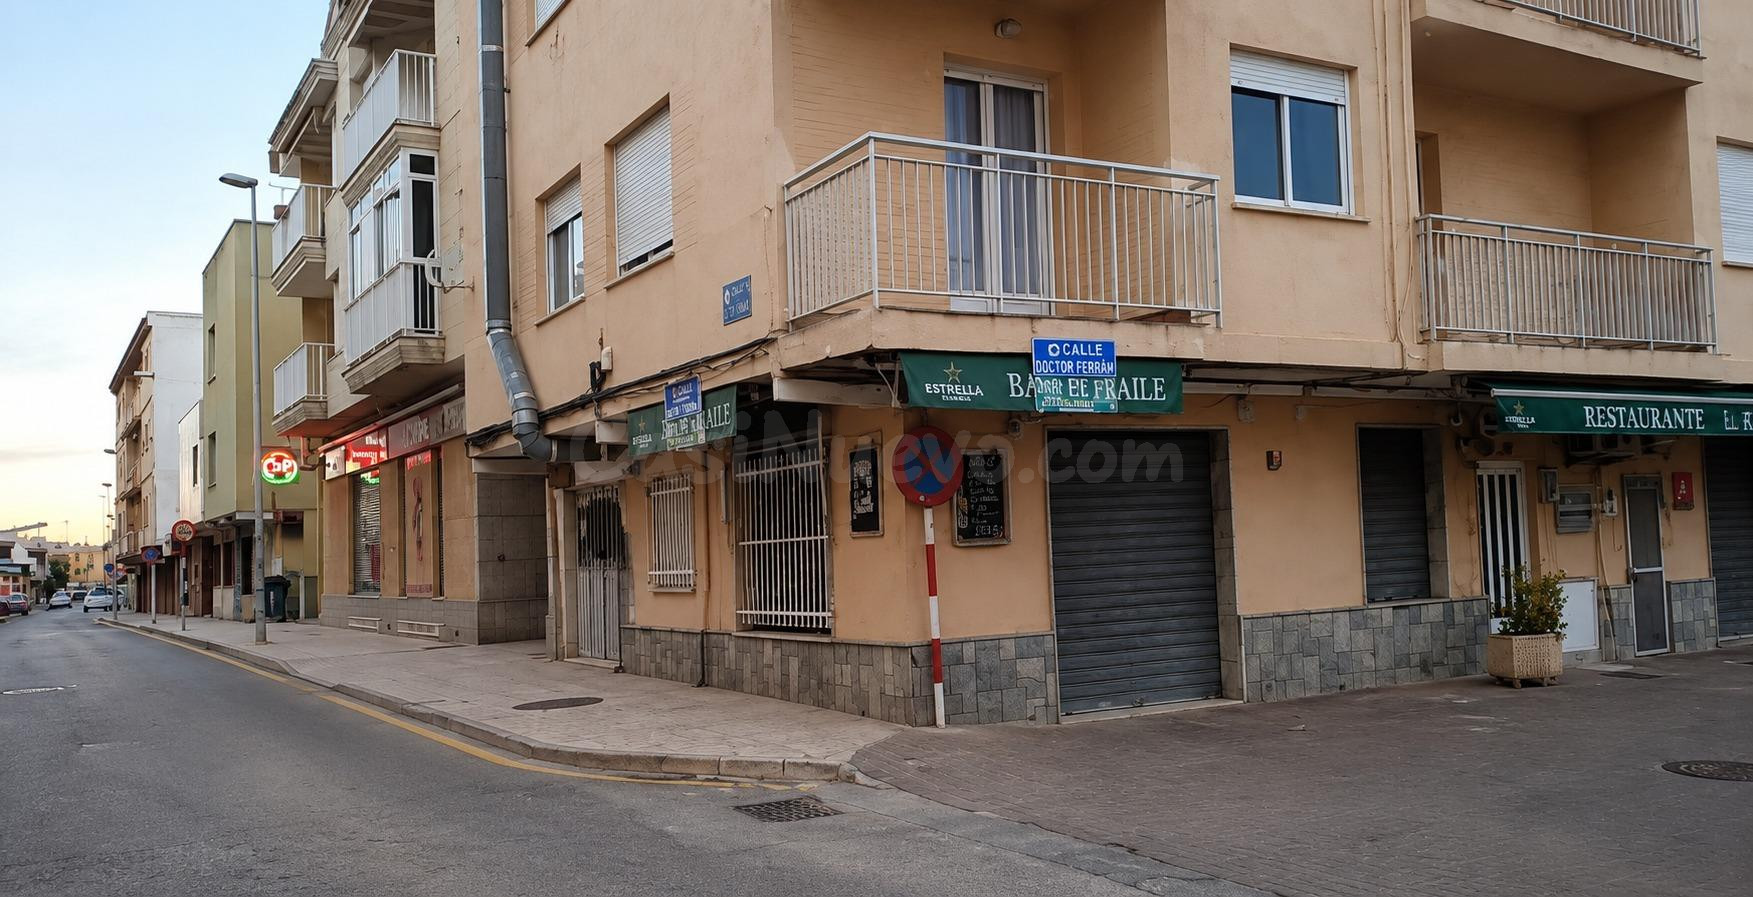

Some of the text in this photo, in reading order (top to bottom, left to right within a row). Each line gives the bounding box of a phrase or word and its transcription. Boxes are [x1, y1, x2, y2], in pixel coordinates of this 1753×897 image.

[1062, 343, 1103, 356] CALLE
[1036, 360, 1074, 373] DOCTOR
[925, 383, 984, 396] ESTRELLA
[1093, 377, 1166, 401] FRAILE
[1583, 405, 1705, 430] RESTAURANTE
